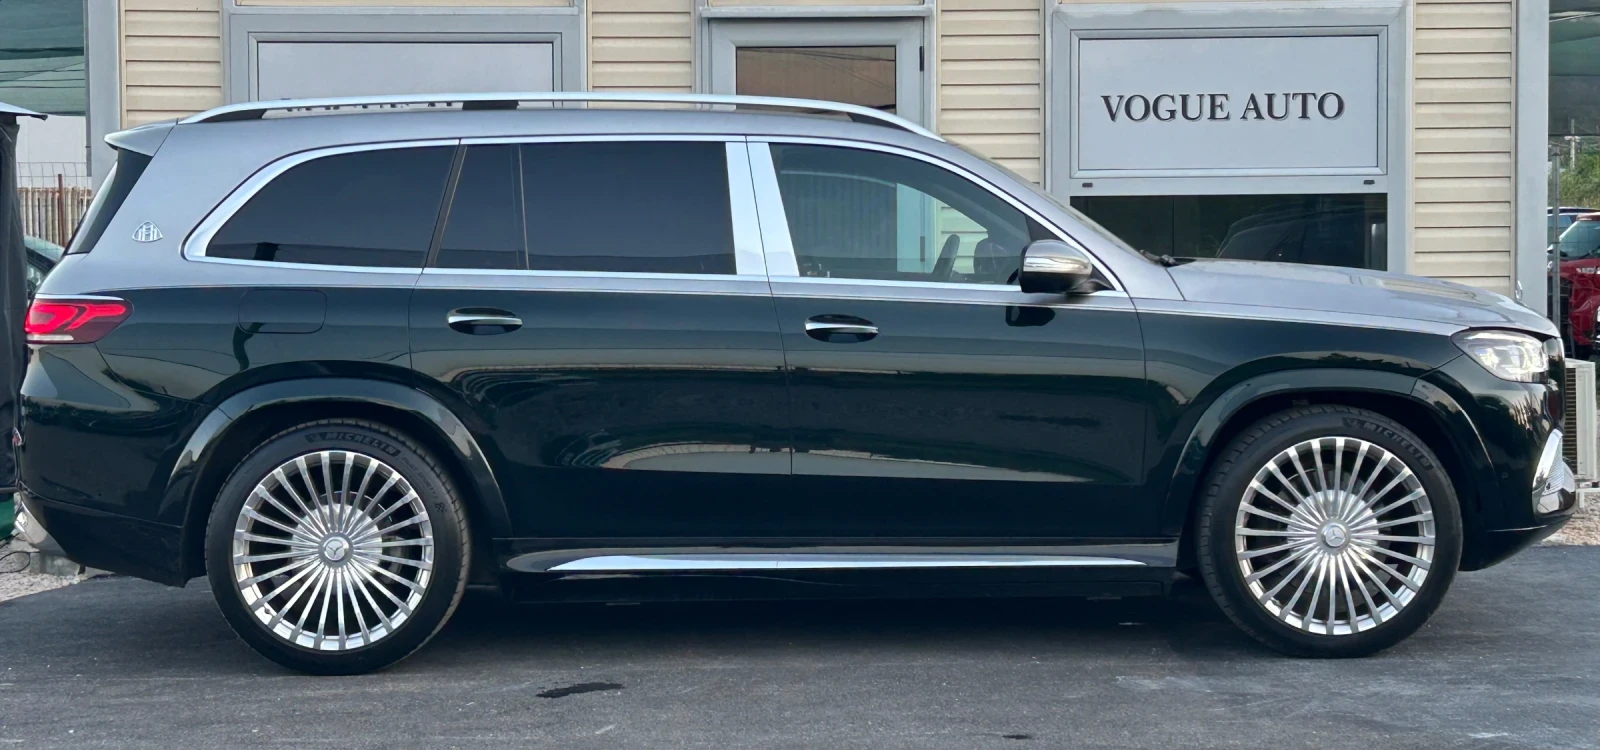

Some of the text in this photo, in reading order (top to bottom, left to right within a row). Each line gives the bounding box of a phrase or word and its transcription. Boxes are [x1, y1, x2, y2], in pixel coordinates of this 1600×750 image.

[1100, 92, 1345, 122] VOGUE AUTO
[325, 432, 398, 455] MICHELIN
